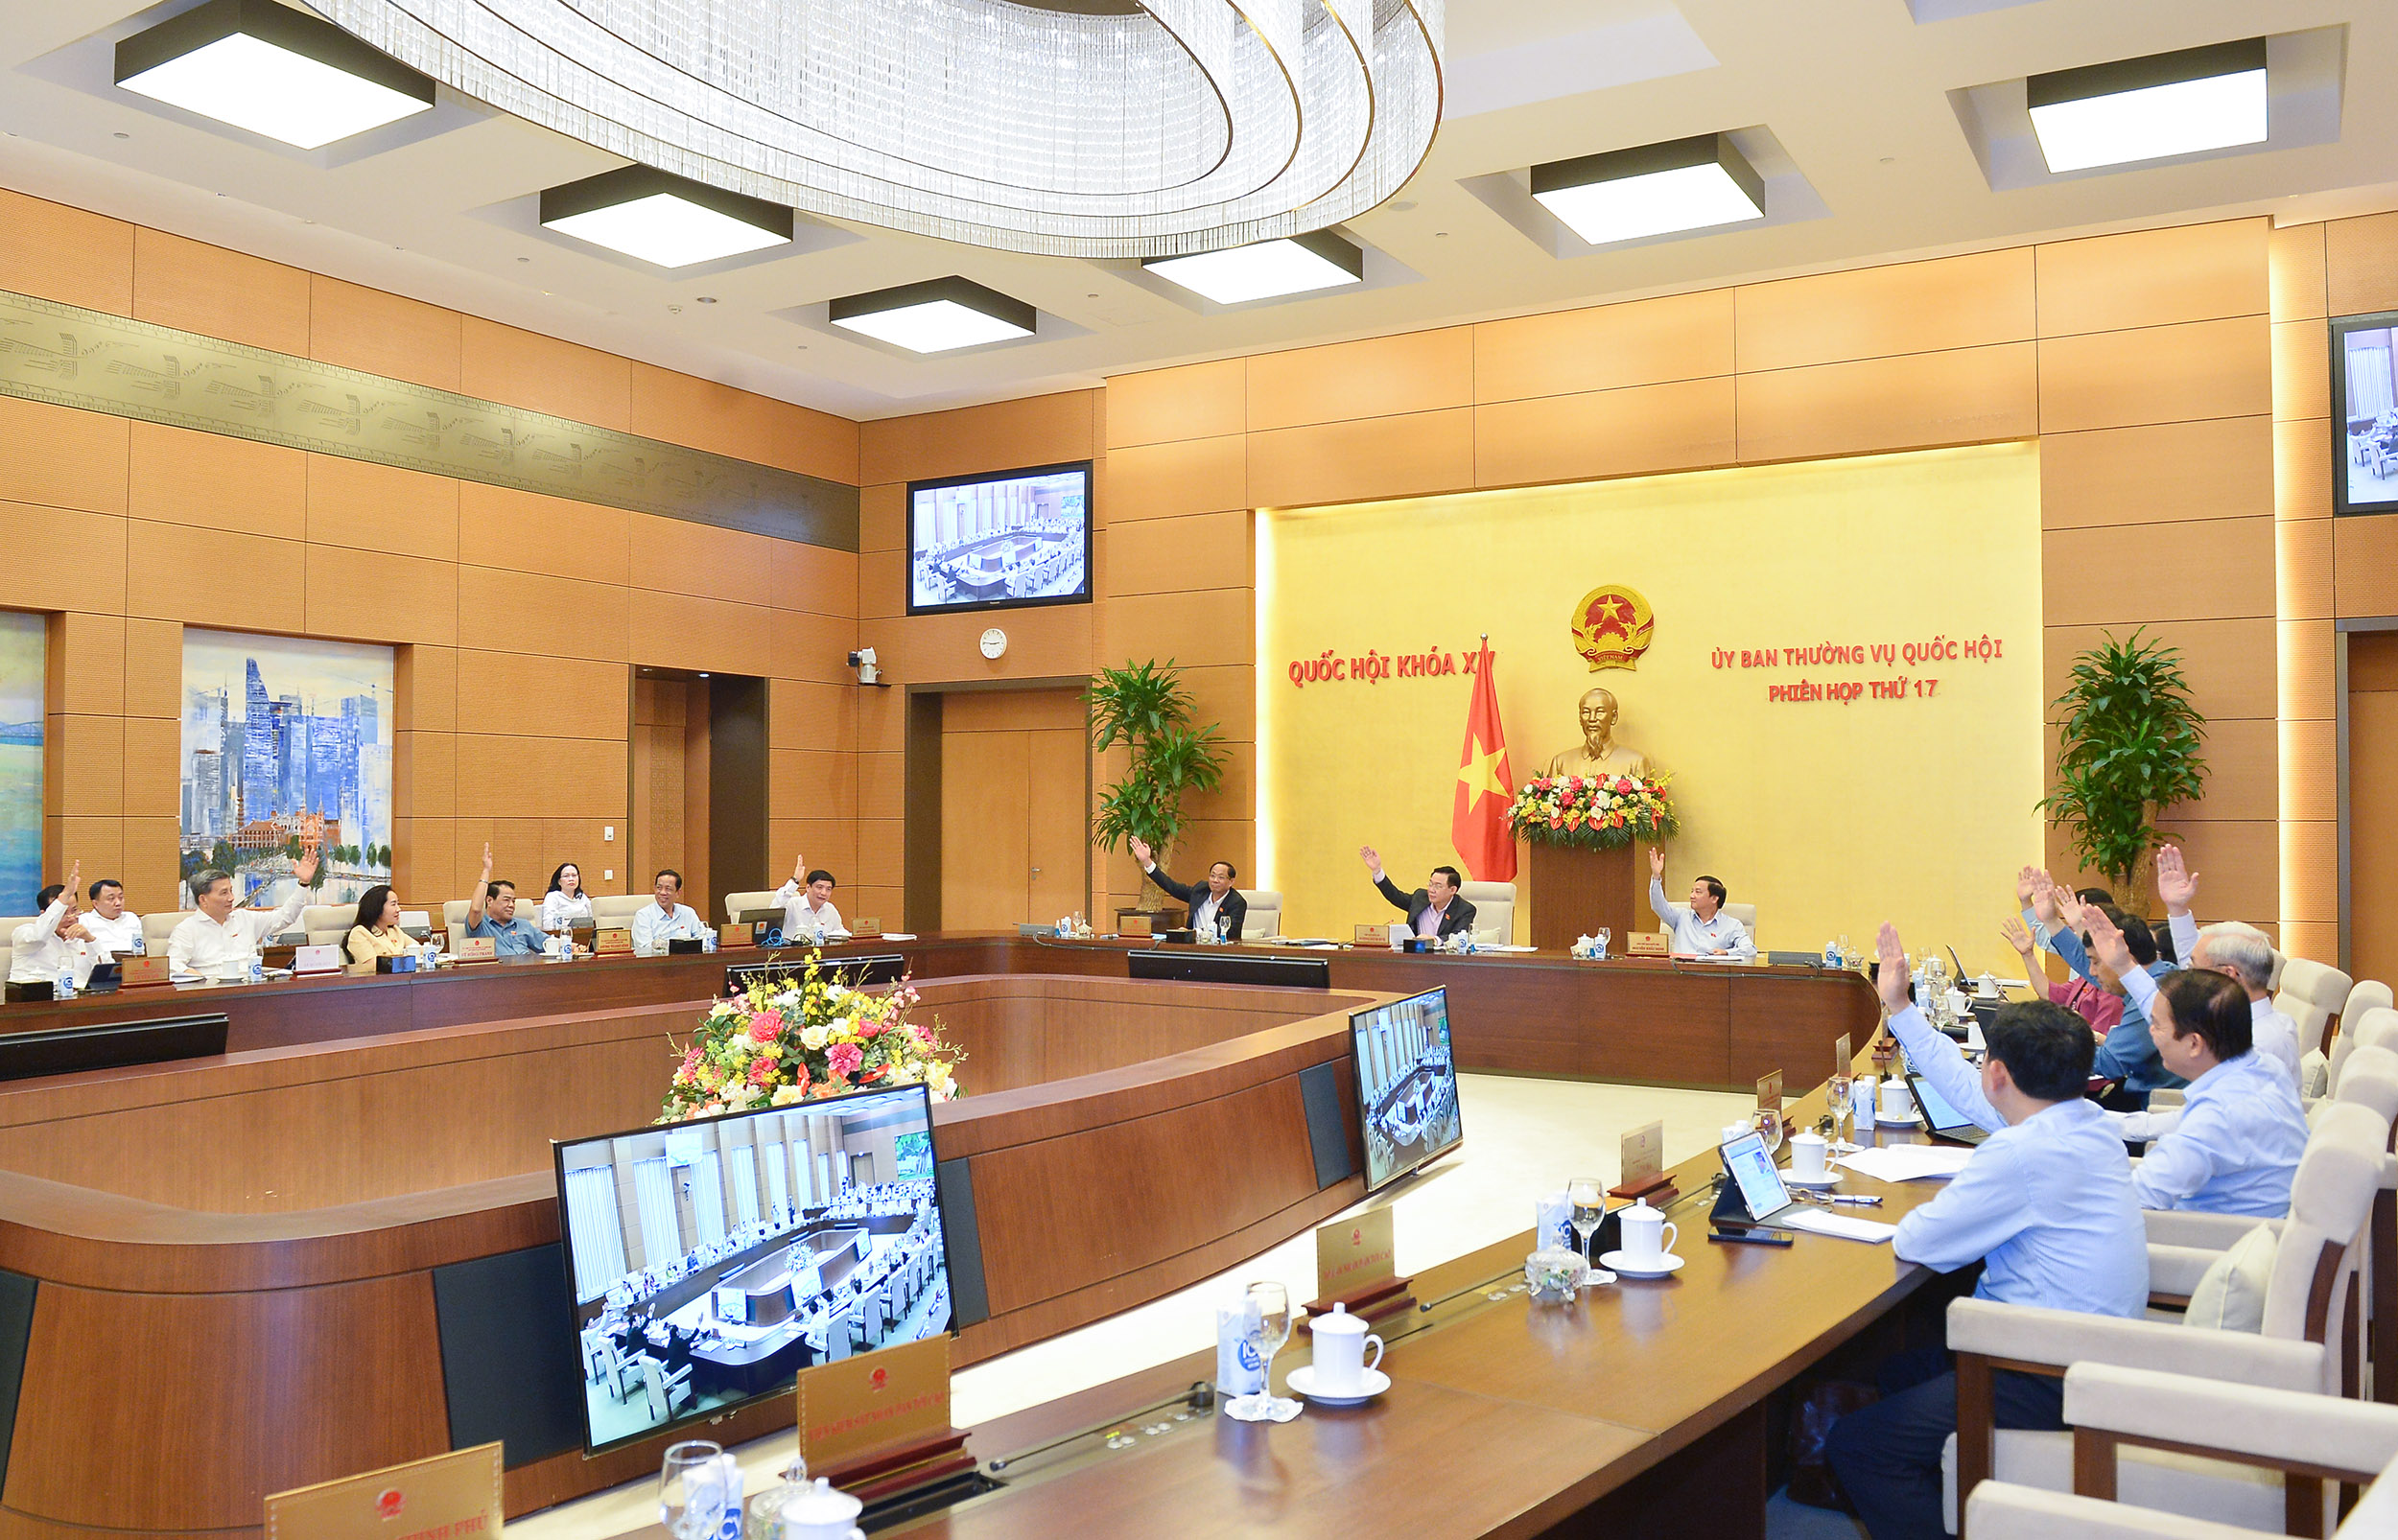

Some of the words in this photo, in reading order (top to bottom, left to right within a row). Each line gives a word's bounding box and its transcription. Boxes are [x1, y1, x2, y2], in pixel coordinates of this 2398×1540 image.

[1288, 649, 1345, 688] QUỐC
[1350, 649, 1390, 684] HỘI
[1397, 645, 1456, 677] KHÓA
[1710, 647, 1735, 668] ỦY
[1740, 649, 1777, 668] BAN
[1783, 641, 1865, 666] THƯỜNG
[1869, 644, 1896, 667] VỤ
[1902, 635, 1958, 665] QUỐC
[1963, 634, 2003, 664] HỘI
[1768, 679, 1822, 703] PHIÊN
[1826, 682, 1864, 705] HỌP
[1869, 676, 1908, 699] THỨ
[1914, 679, 1939, 698] 17
